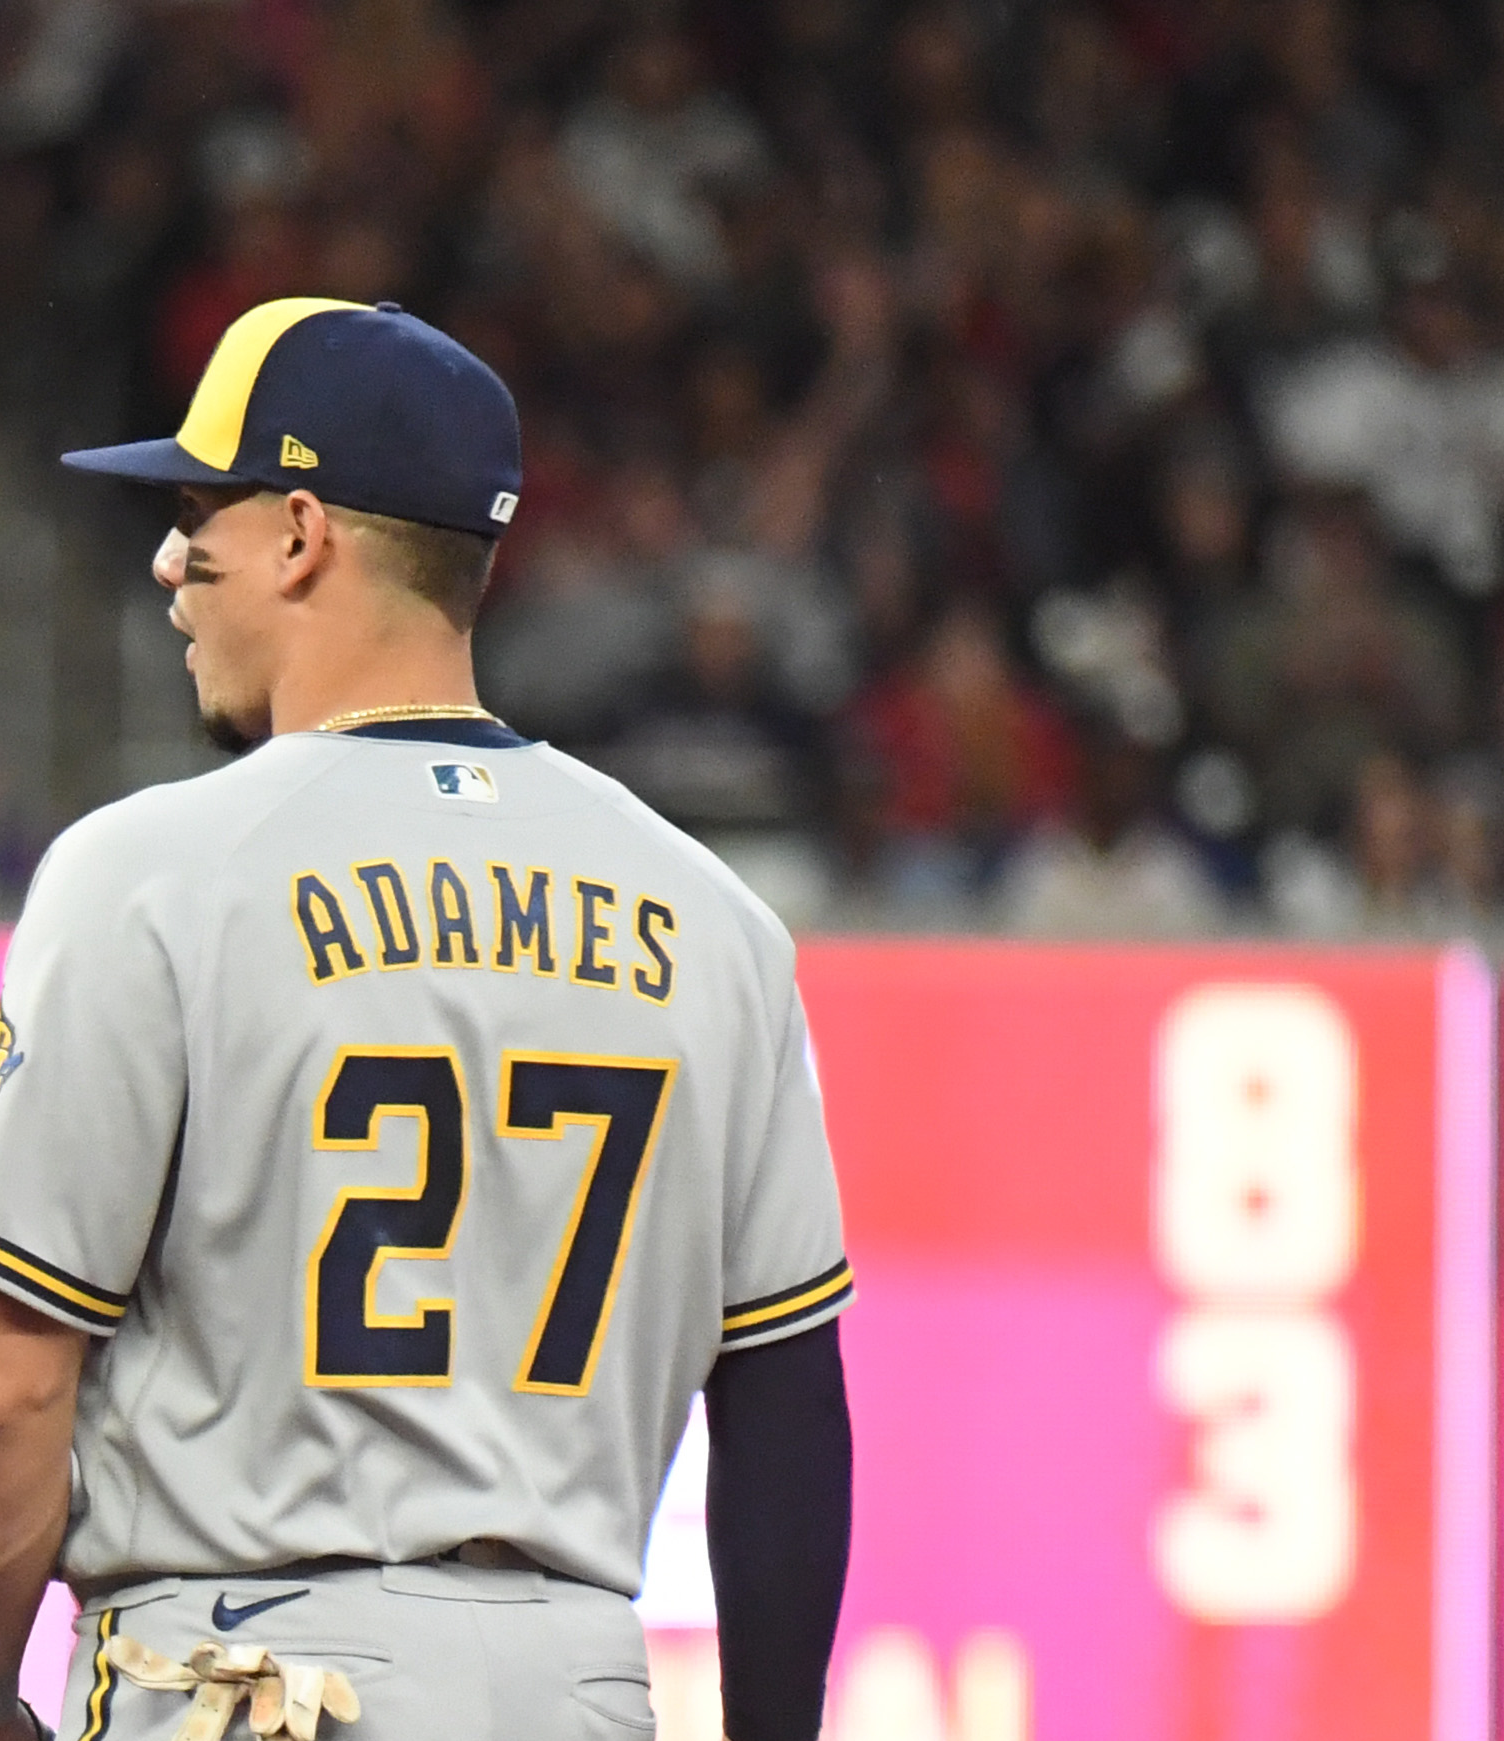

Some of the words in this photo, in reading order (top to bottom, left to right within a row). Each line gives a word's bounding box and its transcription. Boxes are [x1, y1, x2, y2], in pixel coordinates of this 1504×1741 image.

[291, 859, 679, 1006] ADAMES
[302, 1044, 681, 1398] 27
[1151, 1304, 1359, 1625] 3
